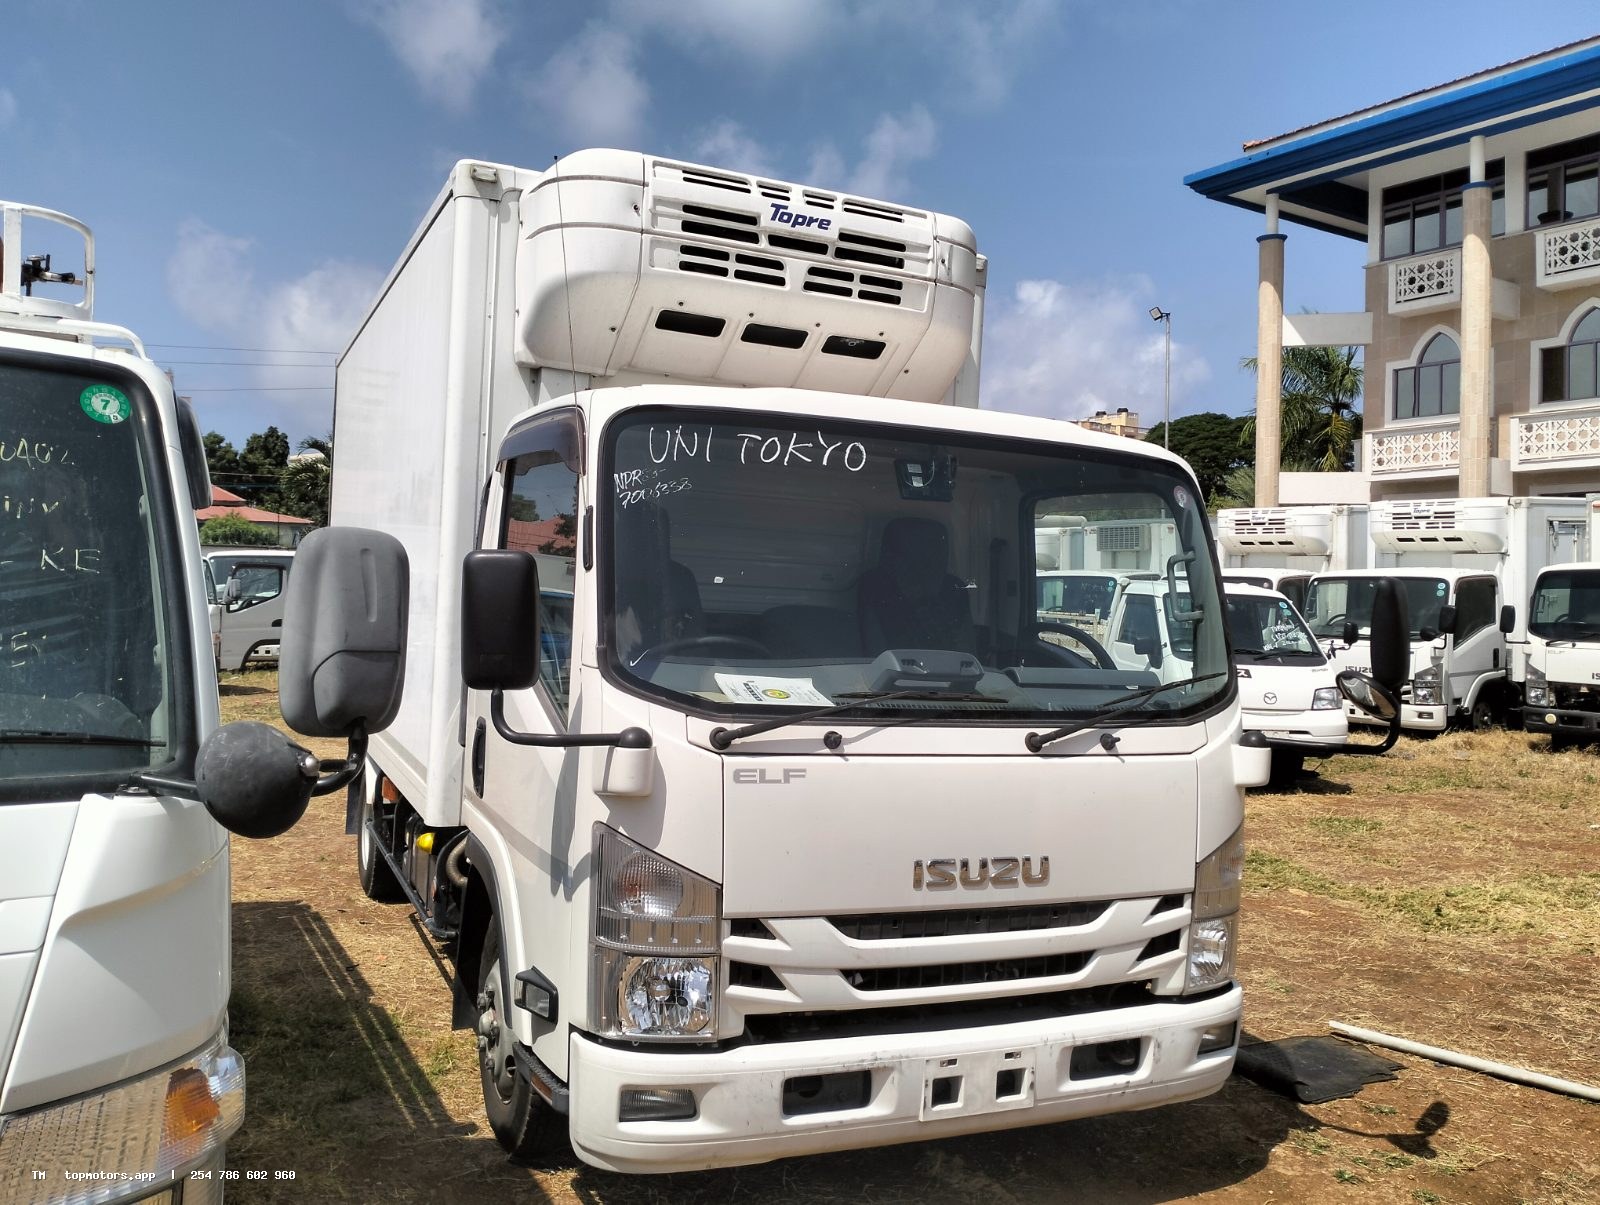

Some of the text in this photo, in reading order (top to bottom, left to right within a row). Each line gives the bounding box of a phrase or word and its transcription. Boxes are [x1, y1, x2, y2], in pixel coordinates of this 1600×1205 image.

[770, 202, 832, 231] Topre
[100, 398, 111, 411] 7
[649, 425, 867, 471] UNI TOKYO
[733, 768, 807, 784] ELF
[912, 855, 1050, 891] ISUZU
